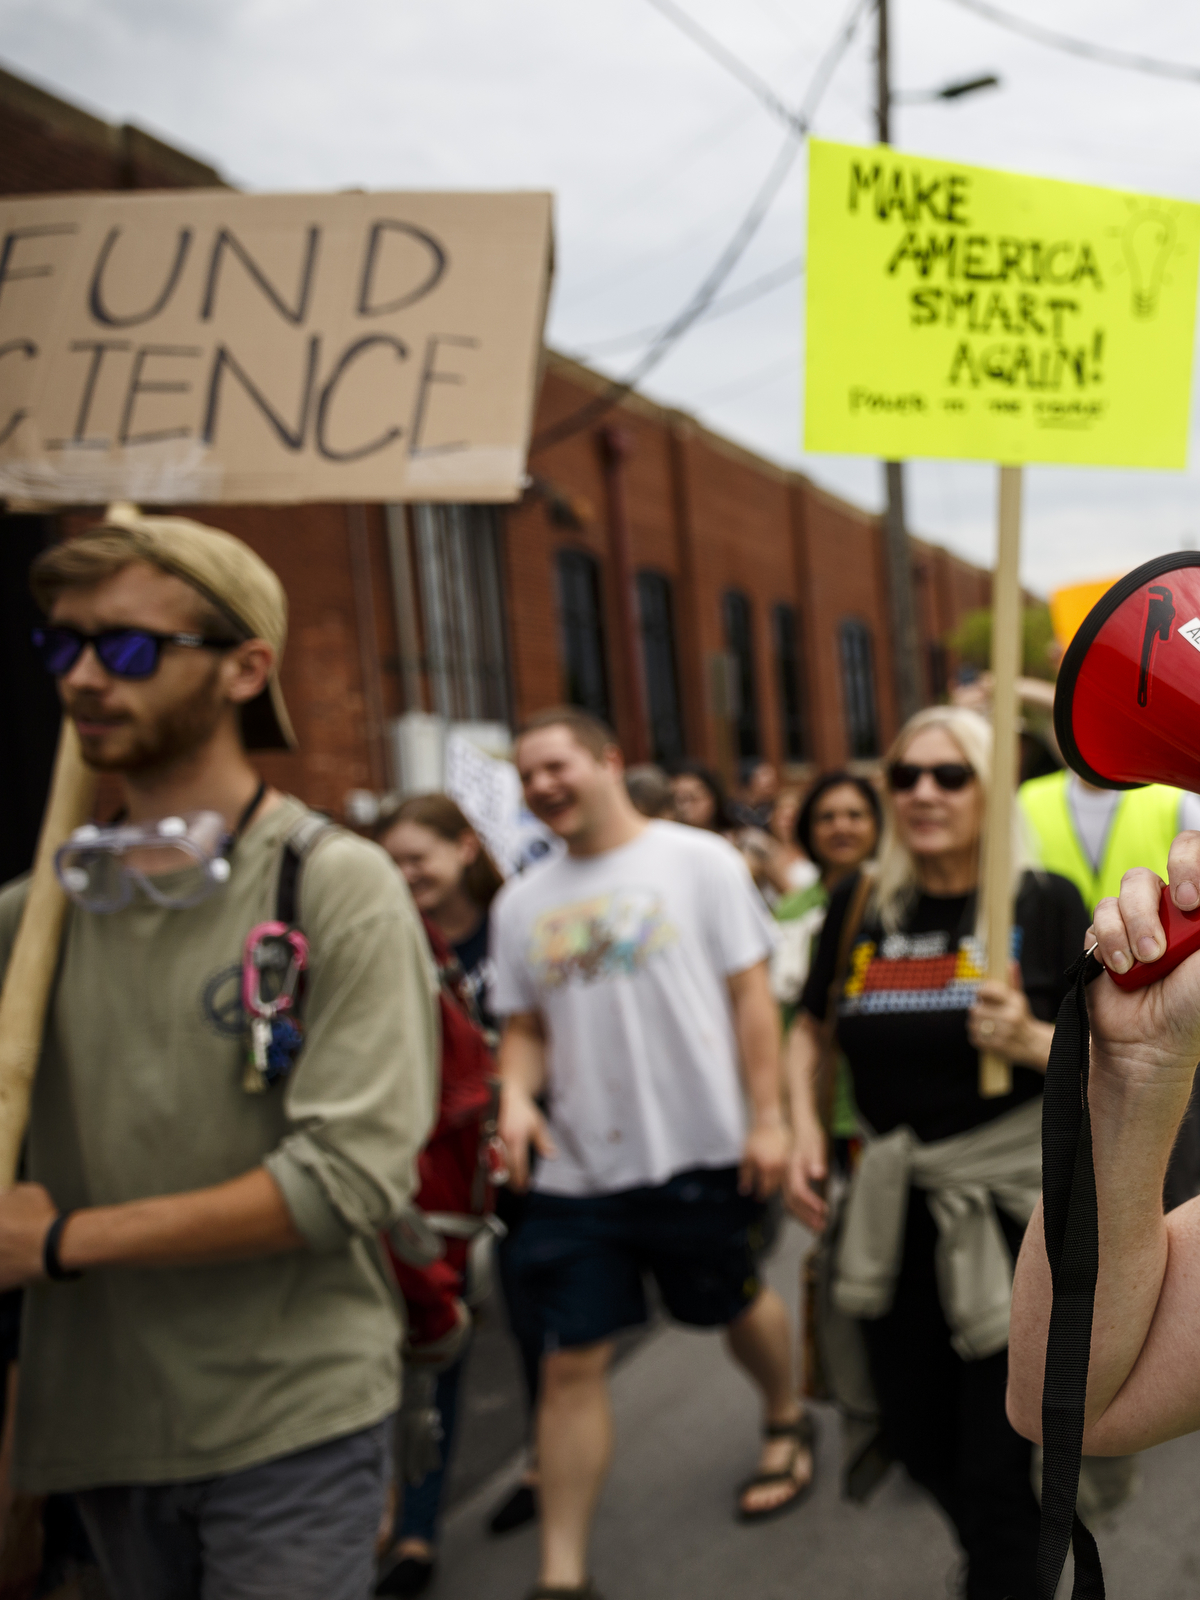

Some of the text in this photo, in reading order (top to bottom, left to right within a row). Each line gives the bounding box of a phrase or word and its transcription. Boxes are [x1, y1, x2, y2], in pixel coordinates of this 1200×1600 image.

[848, 159, 970, 226] MAKE
[0, 216, 450, 328] FUND
[886, 230, 1105, 293] AMERICA
[909, 286, 1080, 342] SMART
[948, 327, 1106, 390] AGAIN!
